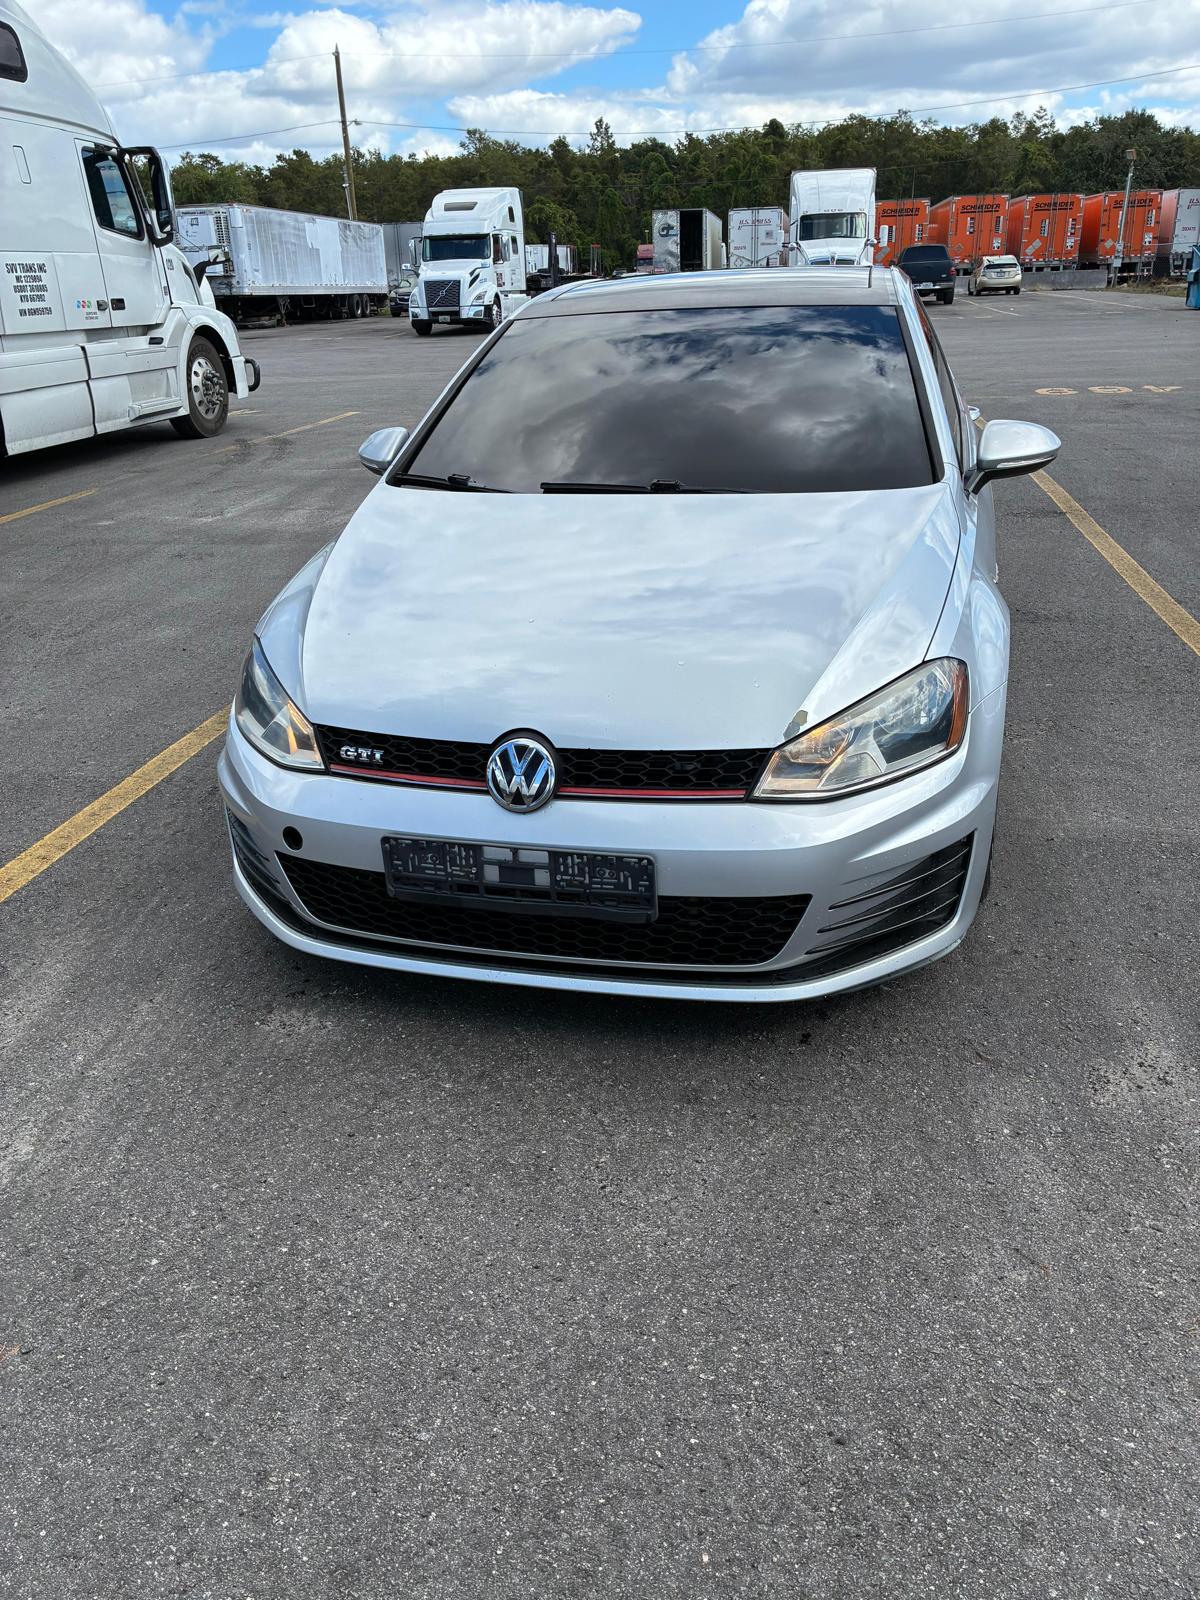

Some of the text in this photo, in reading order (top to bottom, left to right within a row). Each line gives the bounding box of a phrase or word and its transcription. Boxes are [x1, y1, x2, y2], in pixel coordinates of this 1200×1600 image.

[961, 203, 1001, 211] SCHNEIDER
[1035, 201, 1075, 209] SCHNEIDER
[881, 207, 921, 215] SCHNEIDER
[5, 262, 47, 274] SVV TRANS INC
[15, 274, 24, 284] MC
[13, 284, 29, 294] USDOT
[19, 308, 28, 317] VIN
[339, 744, 385, 765] GTI
